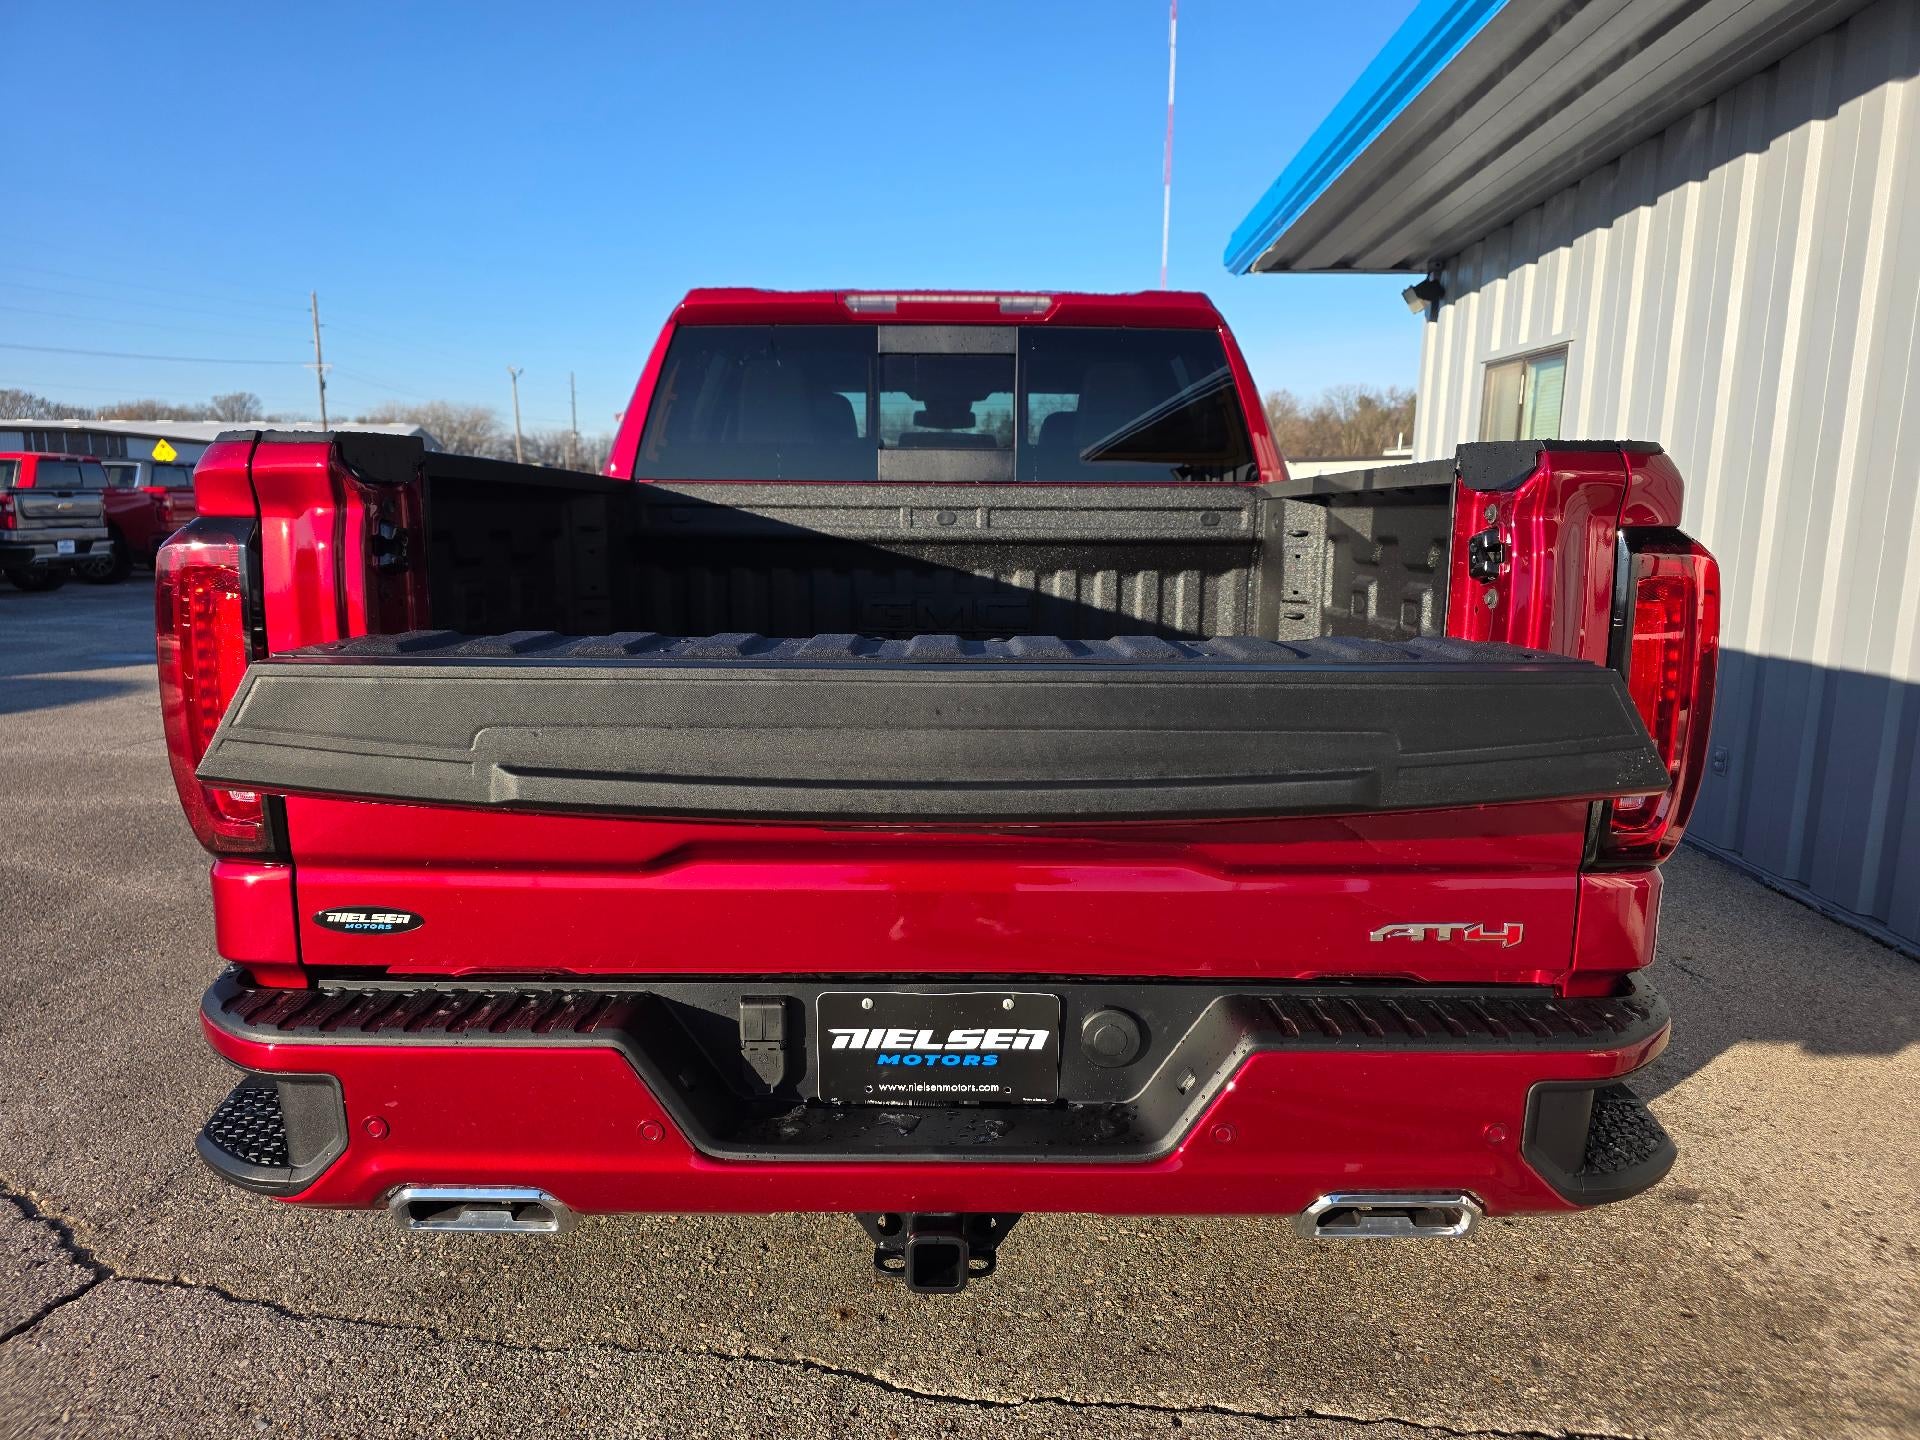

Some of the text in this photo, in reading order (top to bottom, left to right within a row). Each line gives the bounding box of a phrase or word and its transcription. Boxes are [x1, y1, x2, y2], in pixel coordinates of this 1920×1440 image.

[325, 912, 411, 924] NIELSEN
[1369, 923, 1523, 948] AT4
[827, 1028, 1050, 1050] NIELSEN
[876, 1054, 999, 1066] MOTORS
[878, 1082, 999, 1092] www.nielsenmotors.com
